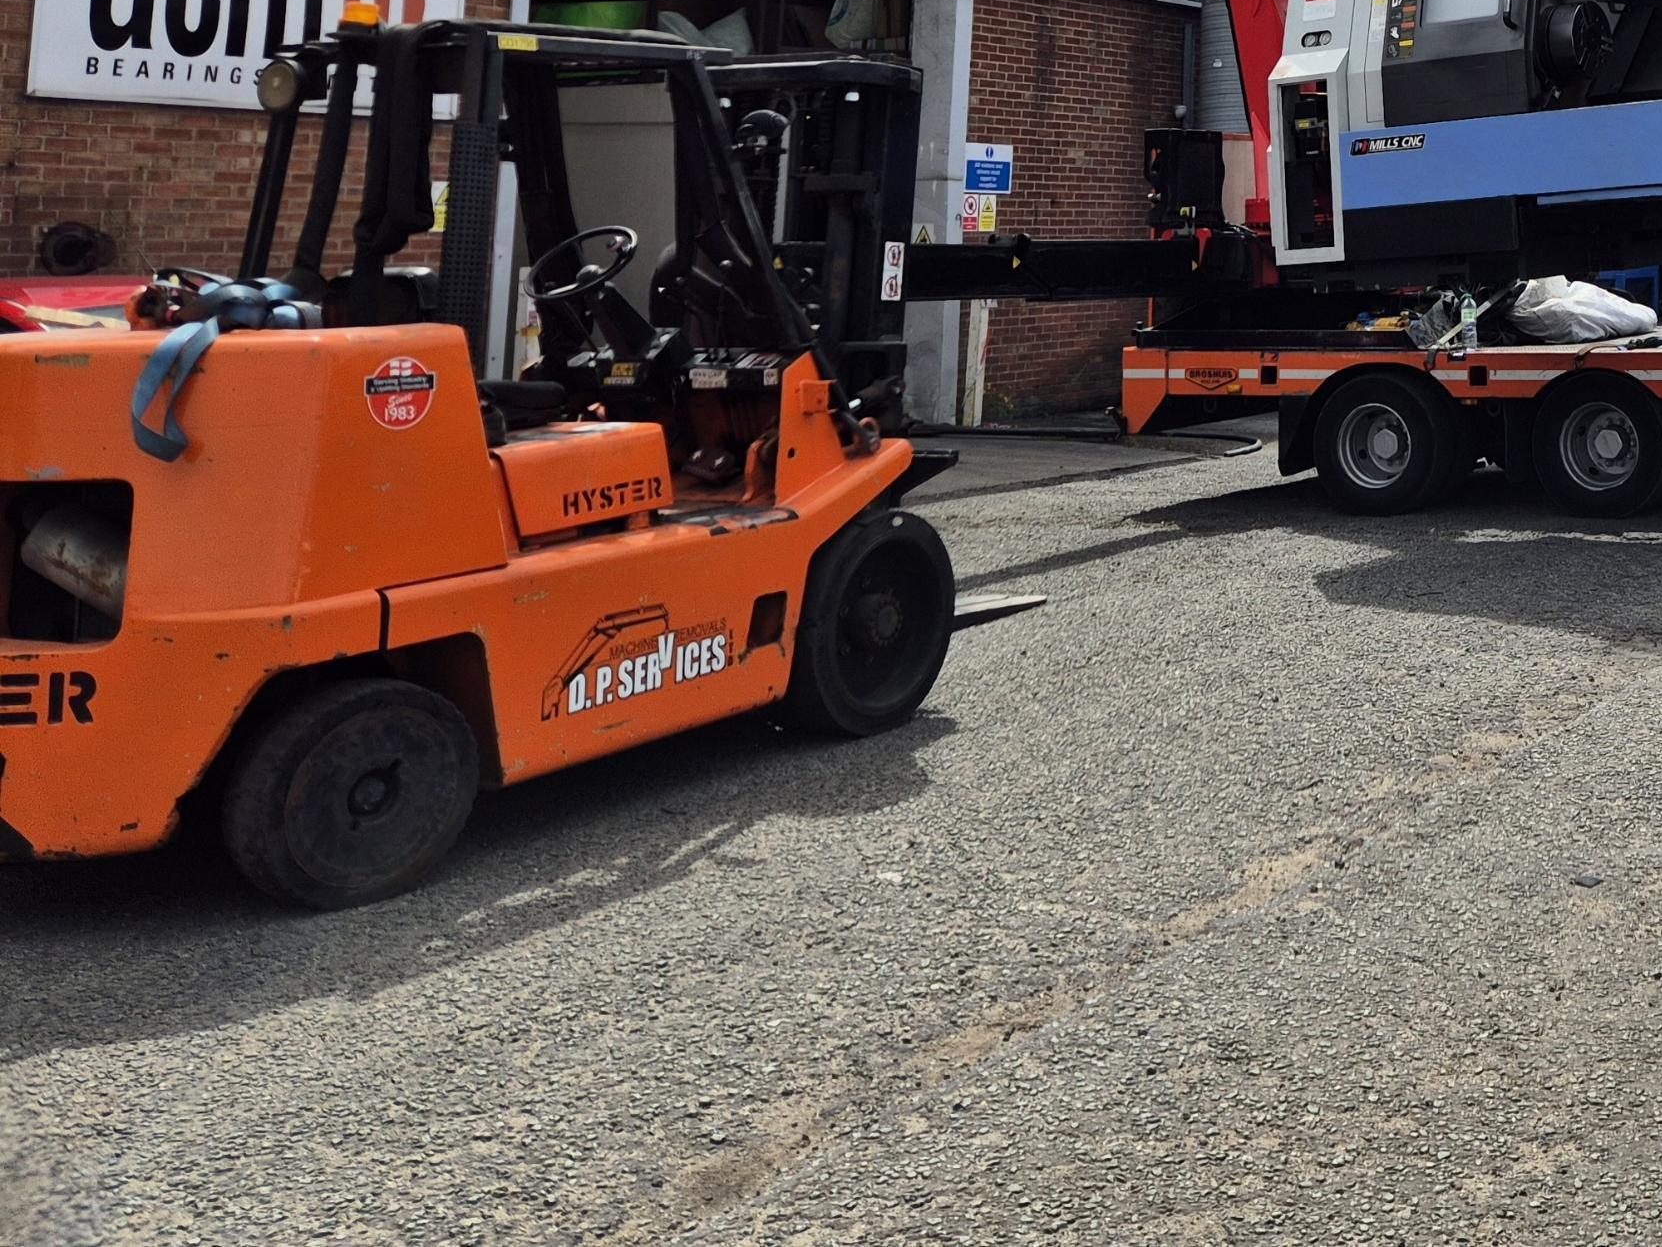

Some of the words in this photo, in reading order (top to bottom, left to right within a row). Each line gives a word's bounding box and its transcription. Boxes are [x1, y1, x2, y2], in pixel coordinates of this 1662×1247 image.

[1370, 138, 1400, 151] MILLS
[1402, 135, 1424, 147] CNC
[384, 405, 416, 422] 1983
[562, 476, 663, 517] HYSTER
[616, 631, 727, 700] SERVICES
